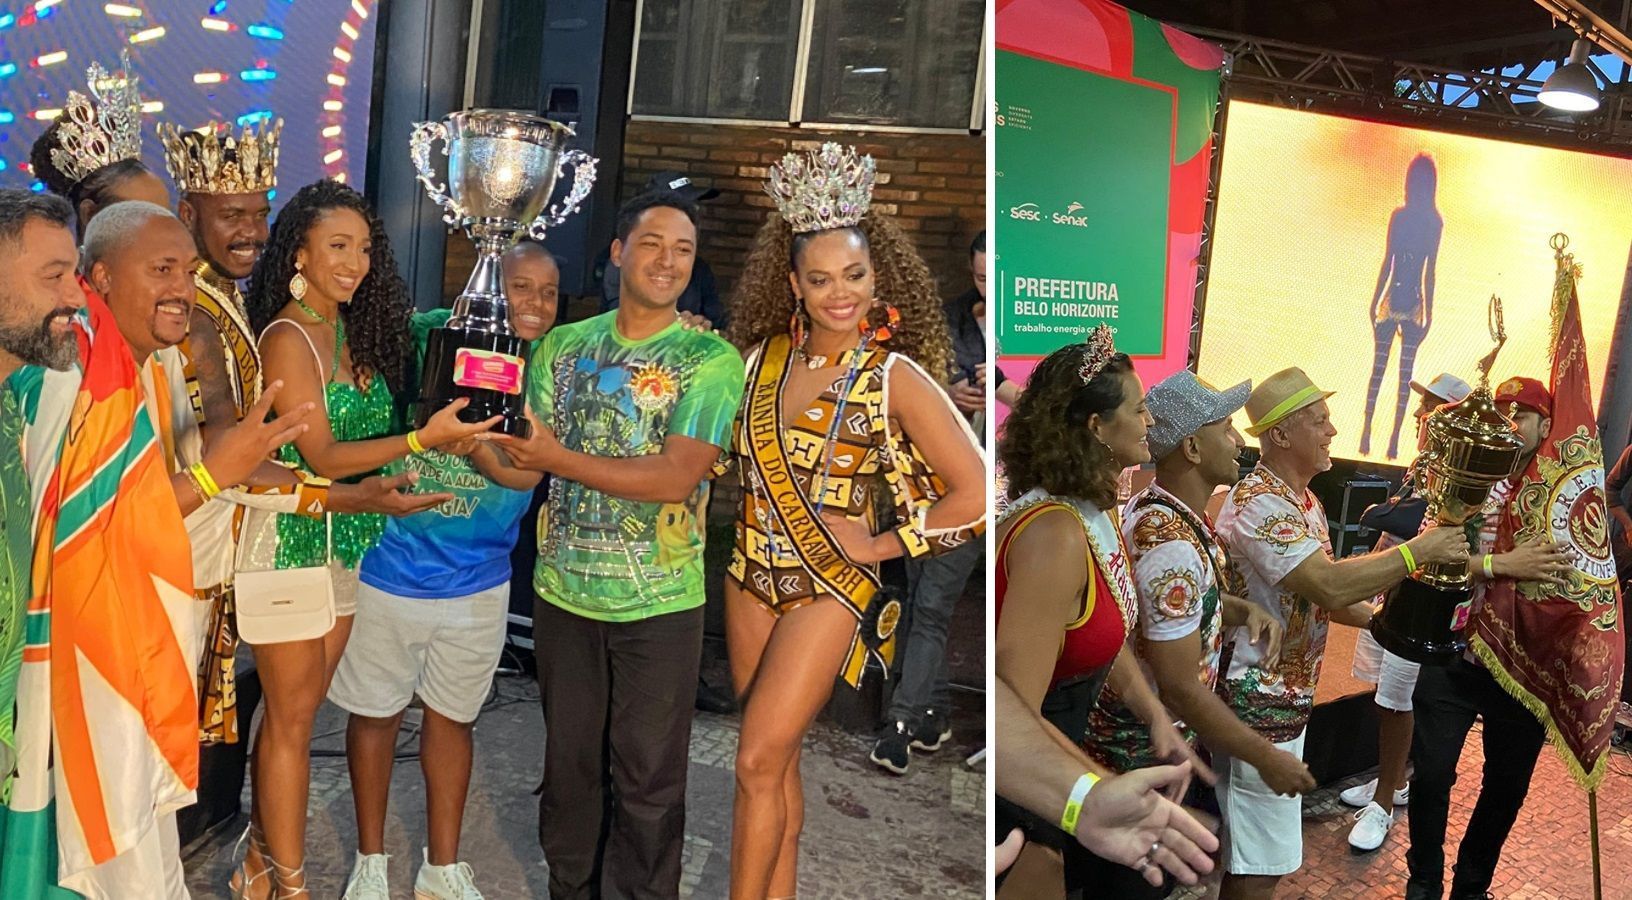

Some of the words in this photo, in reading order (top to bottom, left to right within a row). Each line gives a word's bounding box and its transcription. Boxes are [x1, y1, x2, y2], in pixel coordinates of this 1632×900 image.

[1010, 206, 1040, 221] Sesc
[1052, 212, 1088, 227] Senac
[1014, 277, 1119, 301] PREFEITURA
[1014, 301, 1048, 316] BELO
[1052, 302, 1119, 318] HORIZONTE
[1014, 323, 1052, 333] trabalho
[1053, 325, 1085, 336] energia
[753, 380, 777, 451] RAINHA
[763, 457, 787, 485] DO
[777, 490, 837, 577] CARNAVAL
[832, 564, 864, 593] BH
